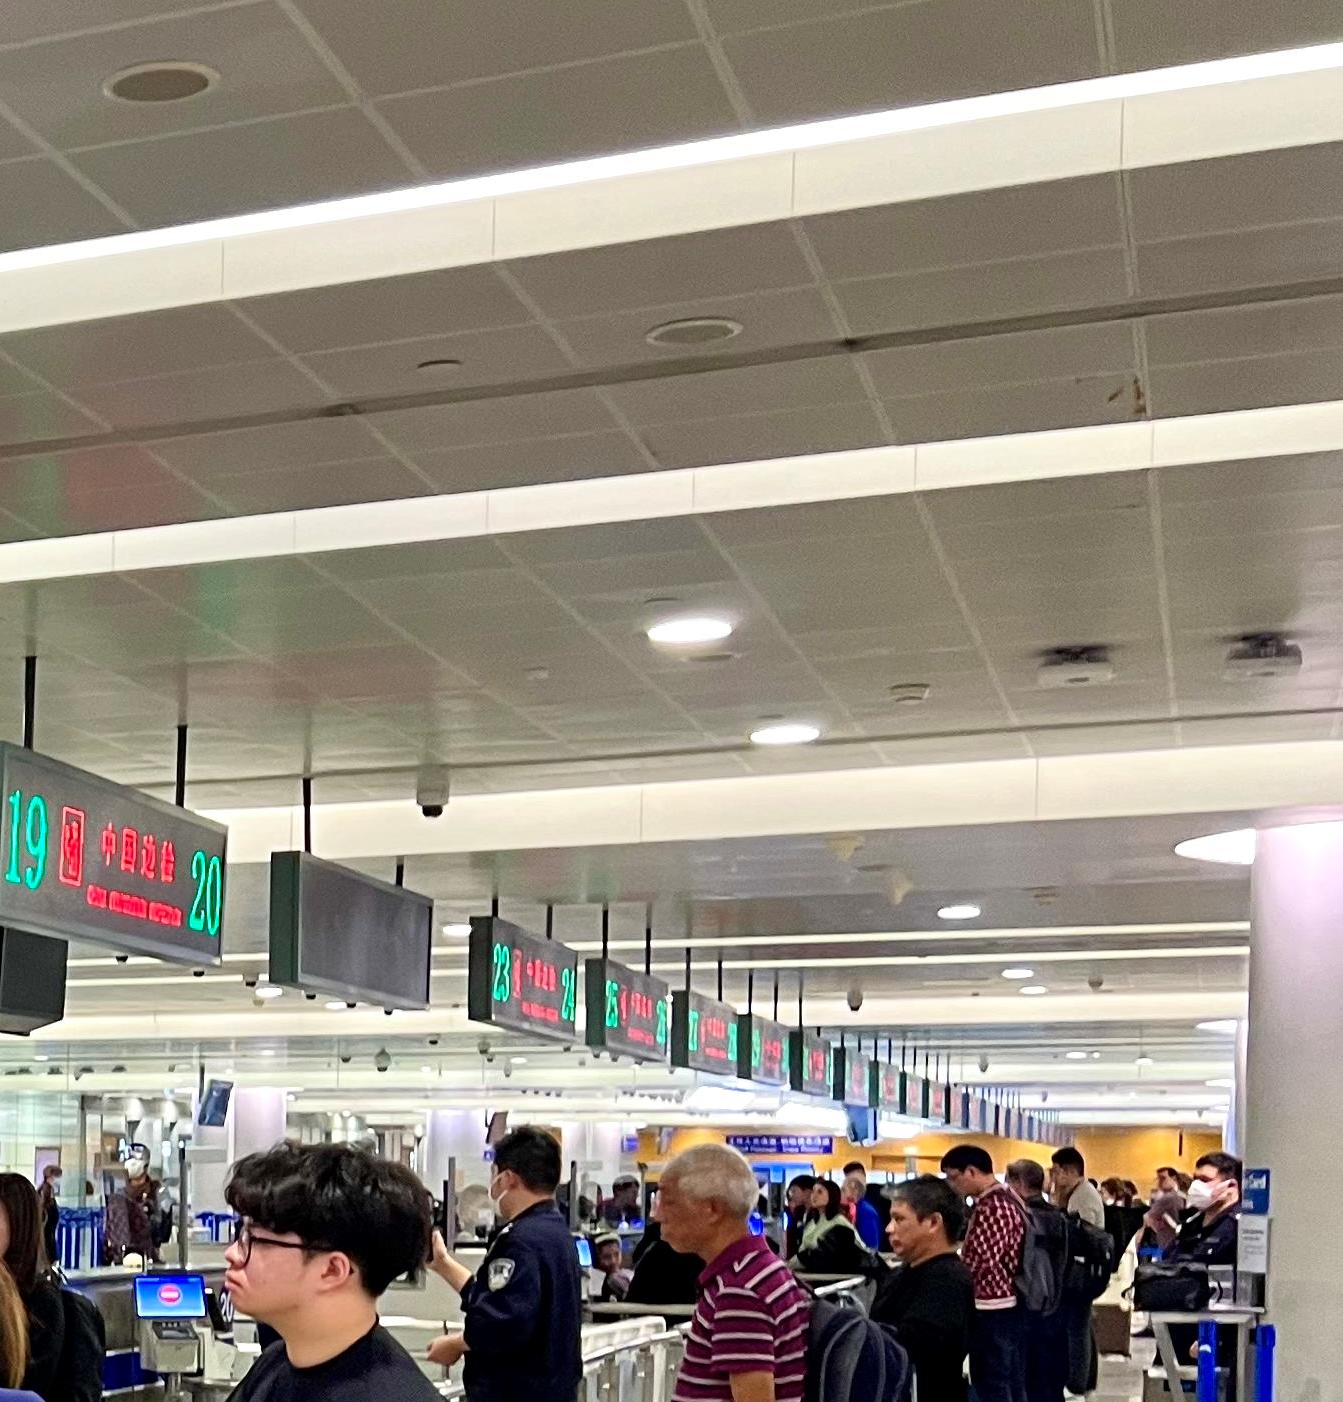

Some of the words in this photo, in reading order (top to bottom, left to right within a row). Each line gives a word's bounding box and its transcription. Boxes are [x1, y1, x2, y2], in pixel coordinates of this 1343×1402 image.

[5, 789, 48, 890] 19
[188, 850, 222, 936] 20
[493, 943, 510, 1002] 23
[561, 967, 575, 1022] 24
